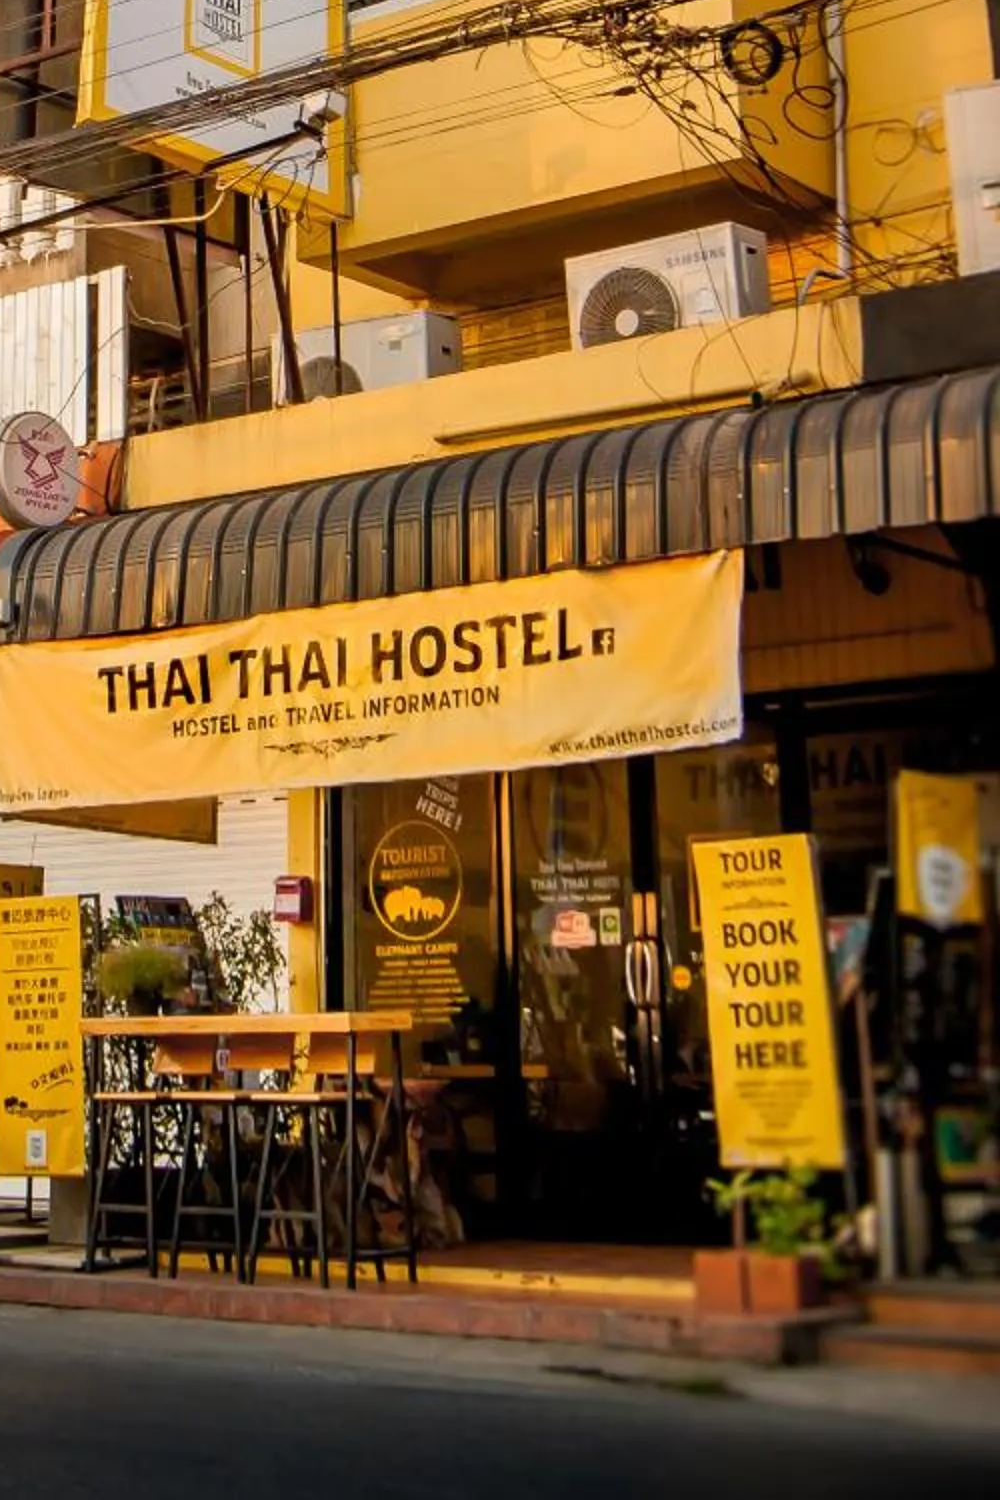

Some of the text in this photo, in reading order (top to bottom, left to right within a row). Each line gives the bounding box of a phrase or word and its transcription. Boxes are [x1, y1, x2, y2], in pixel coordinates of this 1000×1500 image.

[203, 8, 243, 43] HOSTEL
[97, 653, 213, 714] THAI
[228, 636, 347, 699] THAI
[371, 608, 583, 684] HOSTEL
[172, 713, 241, 739] HOSTEL
[285, 699, 356, 728] TRAVEL
[362, 685, 501, 719] INFORMATION
[380, 845, 447, 866] TOURIST
[719, 848, 783, 875] TOUR
[722, 918, 799, 949] BOOK
[725, 959, 802, 989] YOUR
[729, 1002, 805, 1030] TOUR
[734, 1042, 808, 1070] HERE
